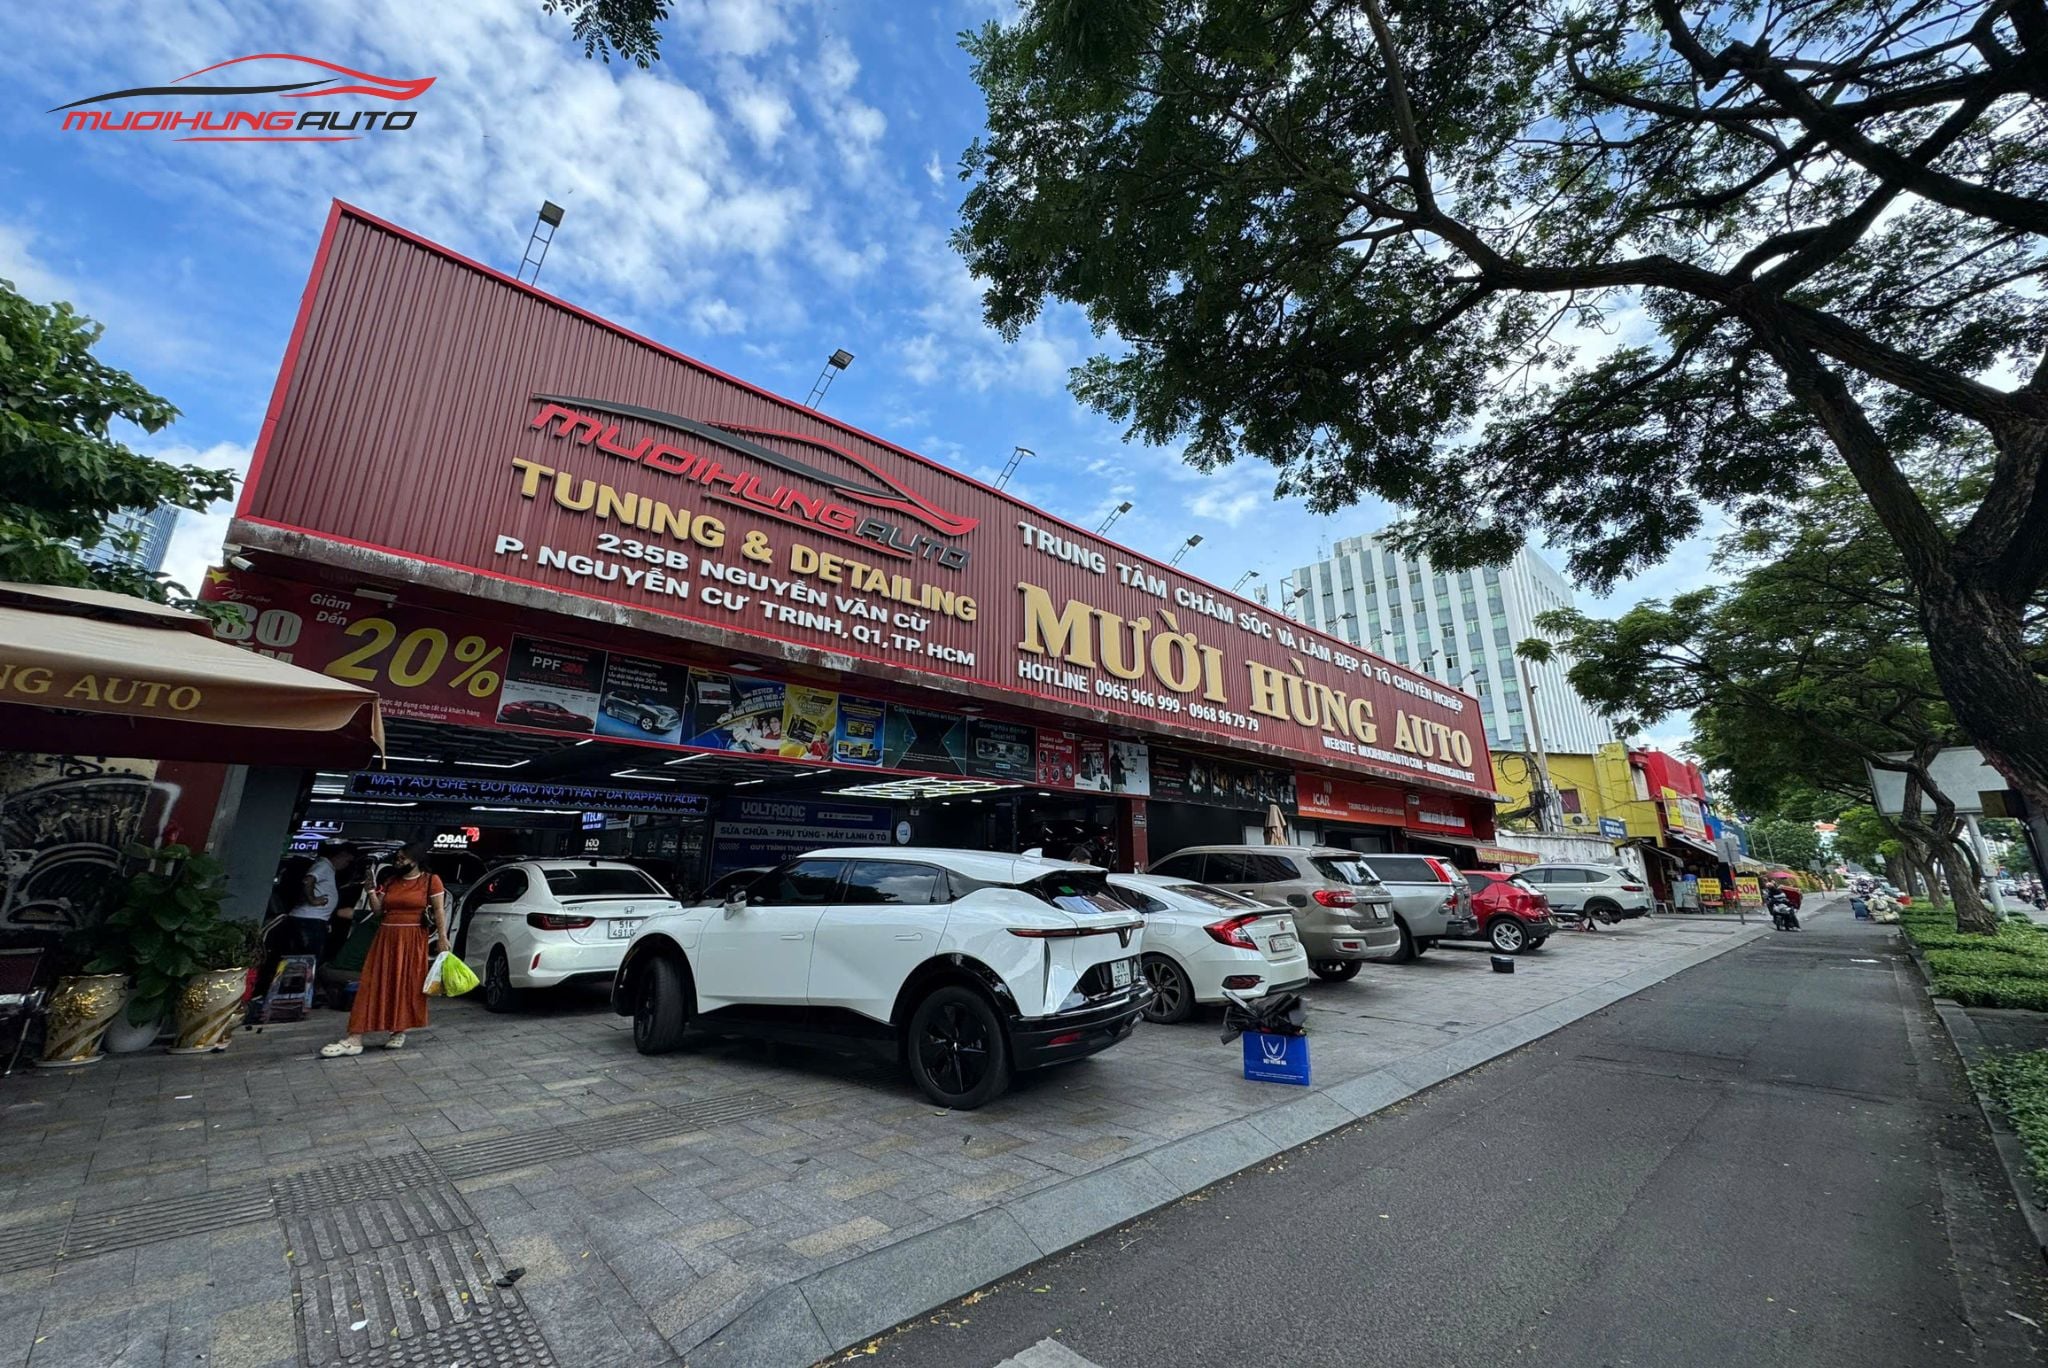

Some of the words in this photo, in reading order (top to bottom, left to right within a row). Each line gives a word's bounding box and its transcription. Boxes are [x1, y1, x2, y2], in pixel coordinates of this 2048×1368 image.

[511, 457, 726, 549] TUNING
[741, 529, 774, 564] &
[790, 543, 978, 622] DETAILING
[596, 532, 690, 571] 235B
[699, 558, 828, 608] NGUYỄN
[834, 595, 888, 624] VĂN
[309, 593, 351, 611] Giảm
[315, 610, 348, 626] Đến
[494, 534, 529, 561] P.
[537, 546, 690, 599] NGUYỄN
[759, 600, 849, 639] TRINH,
[927, 642, 976, 667] HCM
[1017, 521, 1106, 574] TRUNG
[1115, 563, 1168, 599] TÂM
[1174, 586, 1234, 624] CHĂM
[1238, 612, 1273, 639] SÓC
[1277, 625, 1298, 649] VÀ
[1299, 636, 1332, 663] LÀM
[1333, 651, 1360, 675] ĐẸP
[1361, 659, 1372, 678] Ô
[1374, 667, 1392, 686] TÔ
[322, 616, 504, 698] 20%
[531, 656, 562, 671] PPF
[1017, 581, 1227, 704] MƯỜI
[1245, 656, 1378, 744] HÙNG
[1393, 709, 1473, 768] AUTO
[63, 673, 202, 711] AUTO
[1095, 679, 1129, 702] 0965
[1131, 688, 1155, 708] 966
[1157, 694, 1180, 713] 999
[1189, 702, 1217, 722] 0968
[740, 801, 806, 816] VOLTRONIC
[434, 833, 469, 844] OBAL
